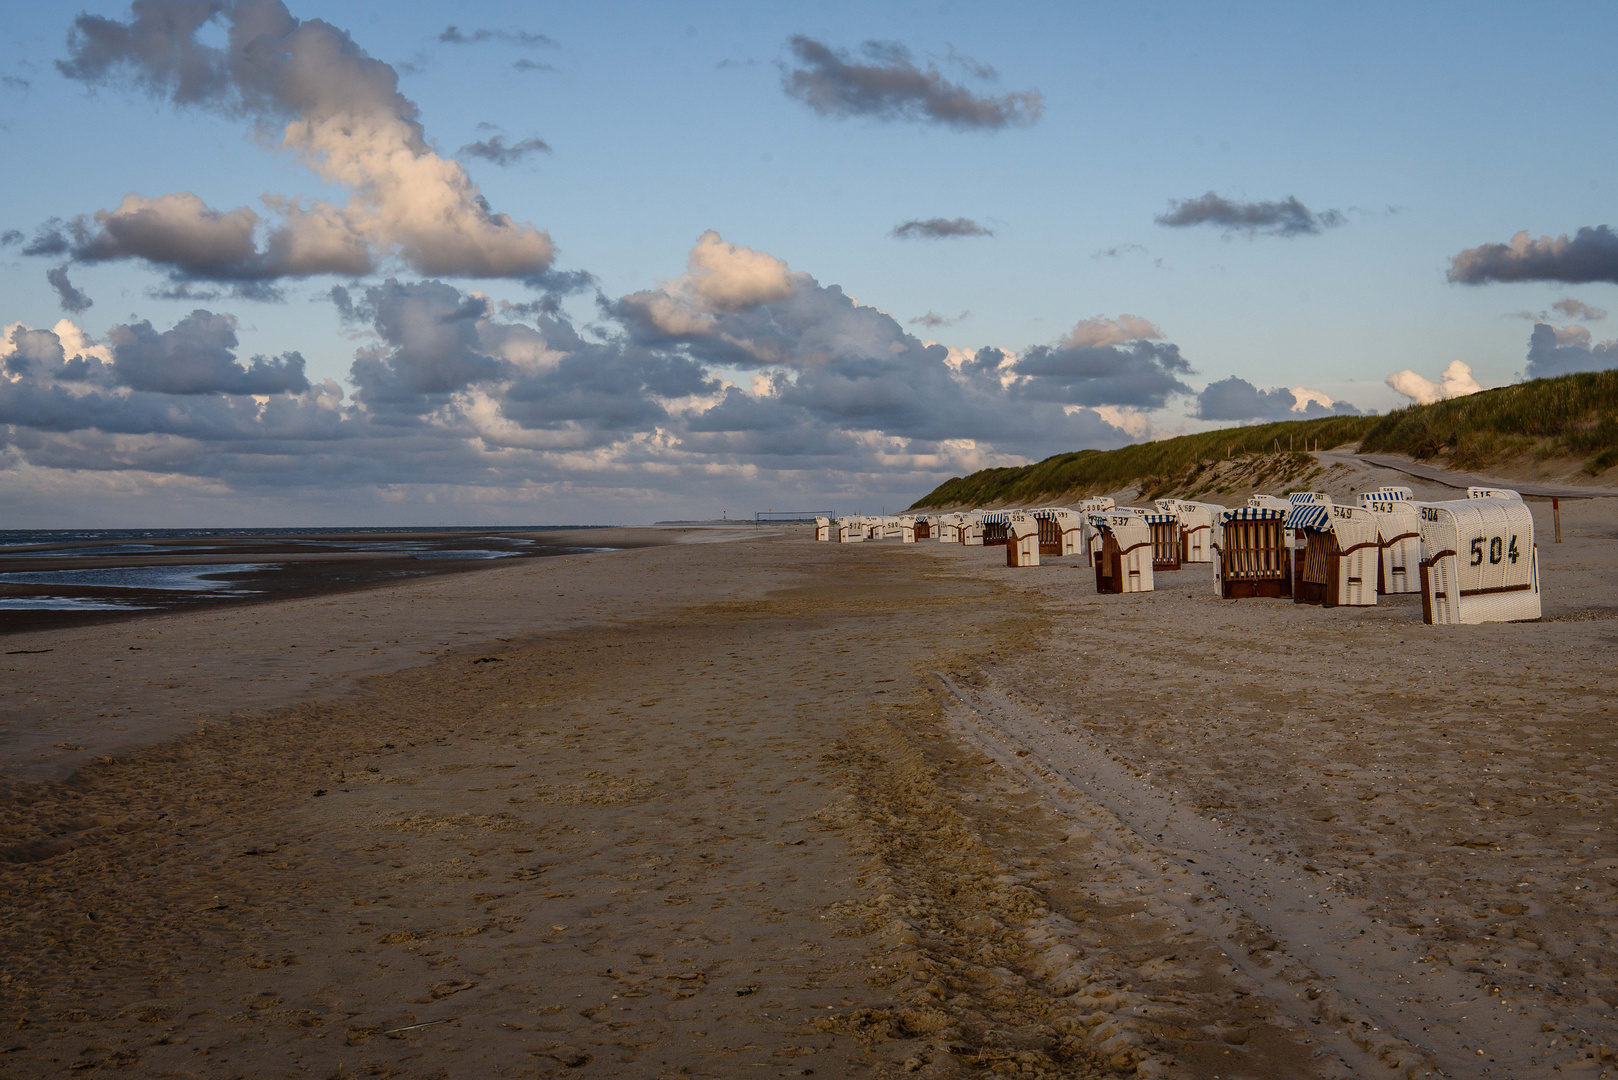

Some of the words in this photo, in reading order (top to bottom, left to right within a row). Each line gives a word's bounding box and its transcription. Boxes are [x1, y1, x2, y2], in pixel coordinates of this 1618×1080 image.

[1334, 506, 1352, 519] 549
[1373, 502, 1393, 513] 543
[1112, 516, 1129, 526] 537
[1422, 508, 1439, 522] 504
[1470, 534, 1520, 568] 504
